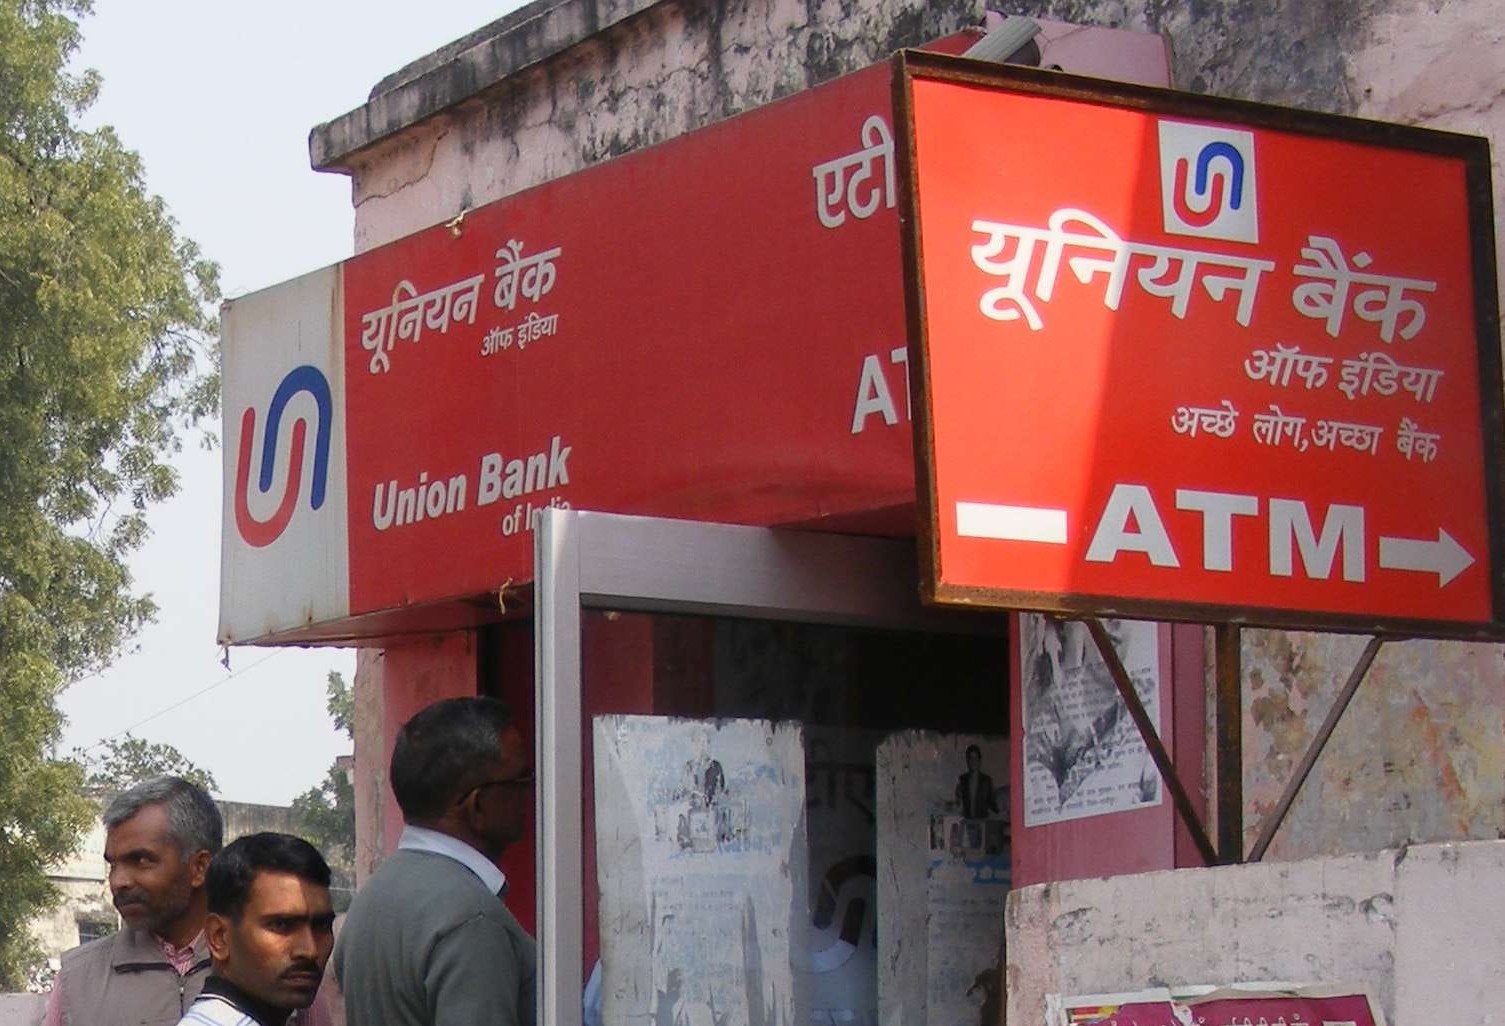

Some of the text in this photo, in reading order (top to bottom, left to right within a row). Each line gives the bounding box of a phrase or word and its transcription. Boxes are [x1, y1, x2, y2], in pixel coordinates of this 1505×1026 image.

[362, 239, 562, 374] यूनियन बैंक
[970, 207, 1437, 343] यूनियन बैंक
[481, 312, 559, 358] ऑफ इंडिया
[1244, 342, 1444, 402] ऑफ इंडिया
[1171, 400, 1238, 439] अच्छे
[1397, 417, 1440, 463] बैंक
[372, 436, 571, 531] Union Bank
[501, 506, 524, 538] of
[1084, 483, 1366, 583] ATM
